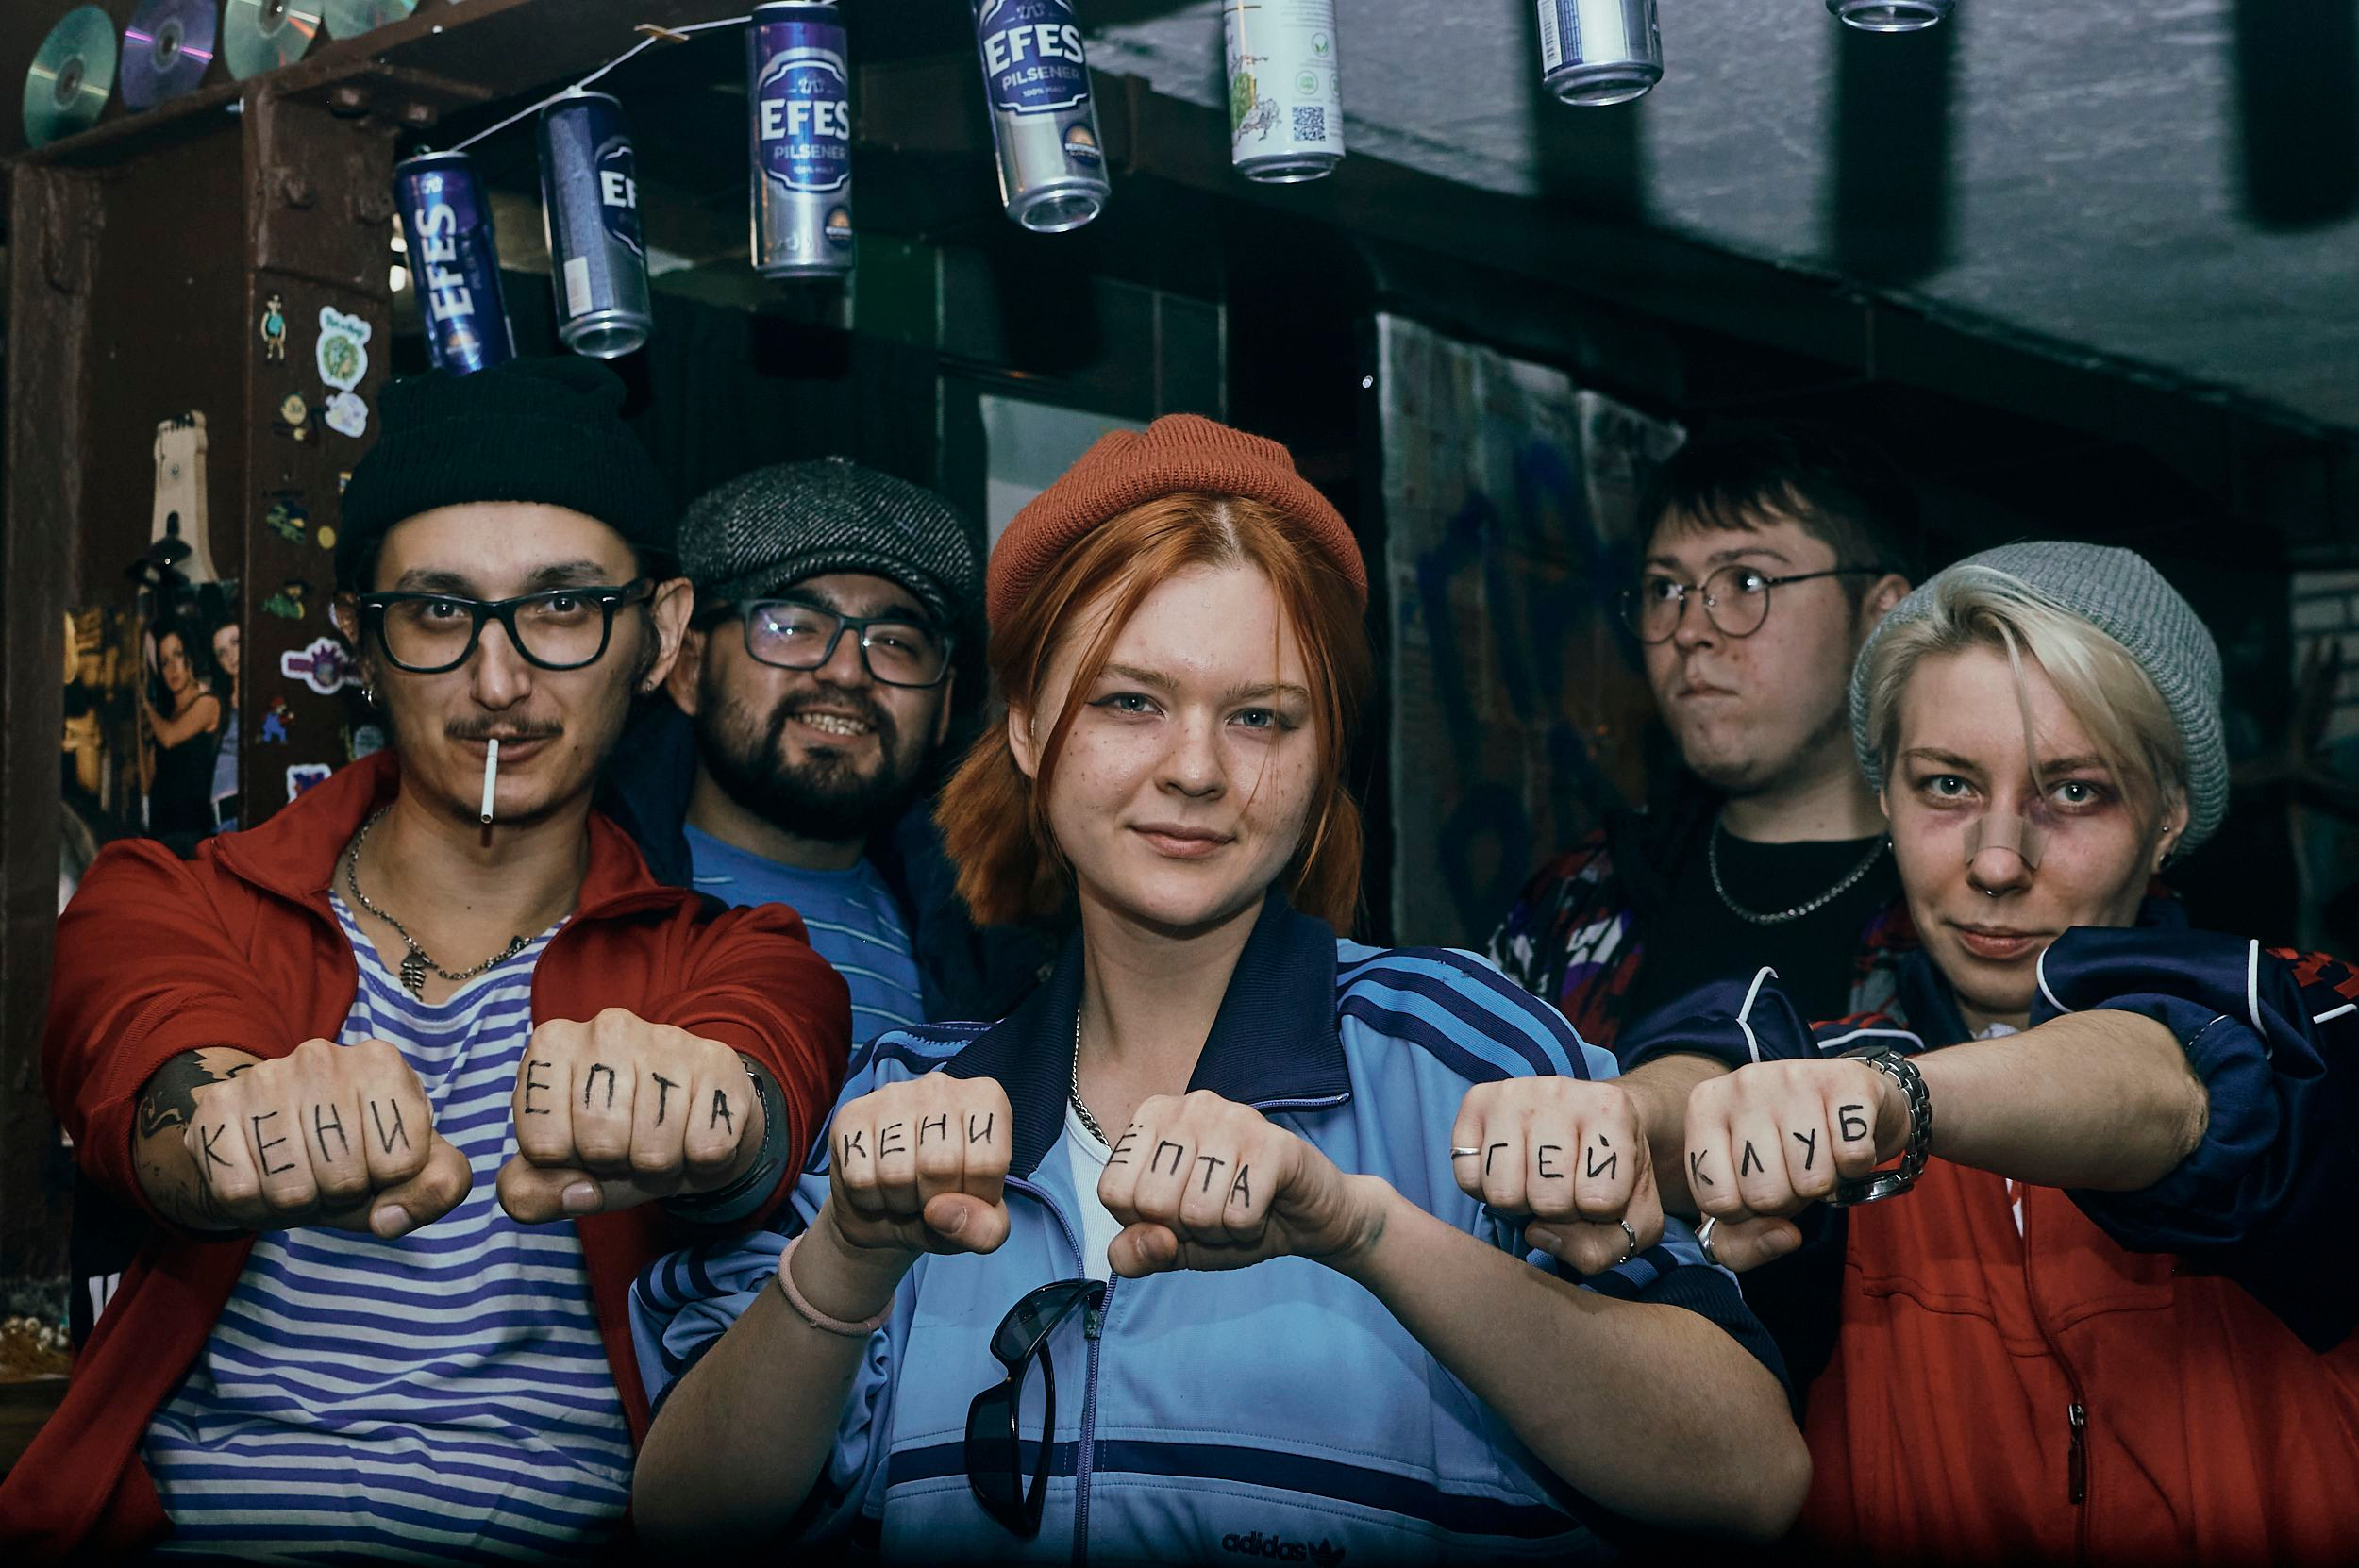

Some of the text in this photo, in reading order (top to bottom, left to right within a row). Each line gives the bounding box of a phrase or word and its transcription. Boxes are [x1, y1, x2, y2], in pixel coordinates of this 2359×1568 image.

[983, 24, 1085, 78] EFES
[1002, 65, 1080, 92] PILSENER
[761, 98, 849, 141] EFES
[774, 143, 847, 160] PILSENER
[415, 203, 475, 322] EFES
[201, 1060, 734, 1182] КЕНИ ЕПТА
[1485, 1104, 1869, 1186] ГЕЙ КЛУБ
[843, 1112, 1251, 1209] КЕНИ ЁПТА
[1222, 1531, 1307, 1562] adidas
